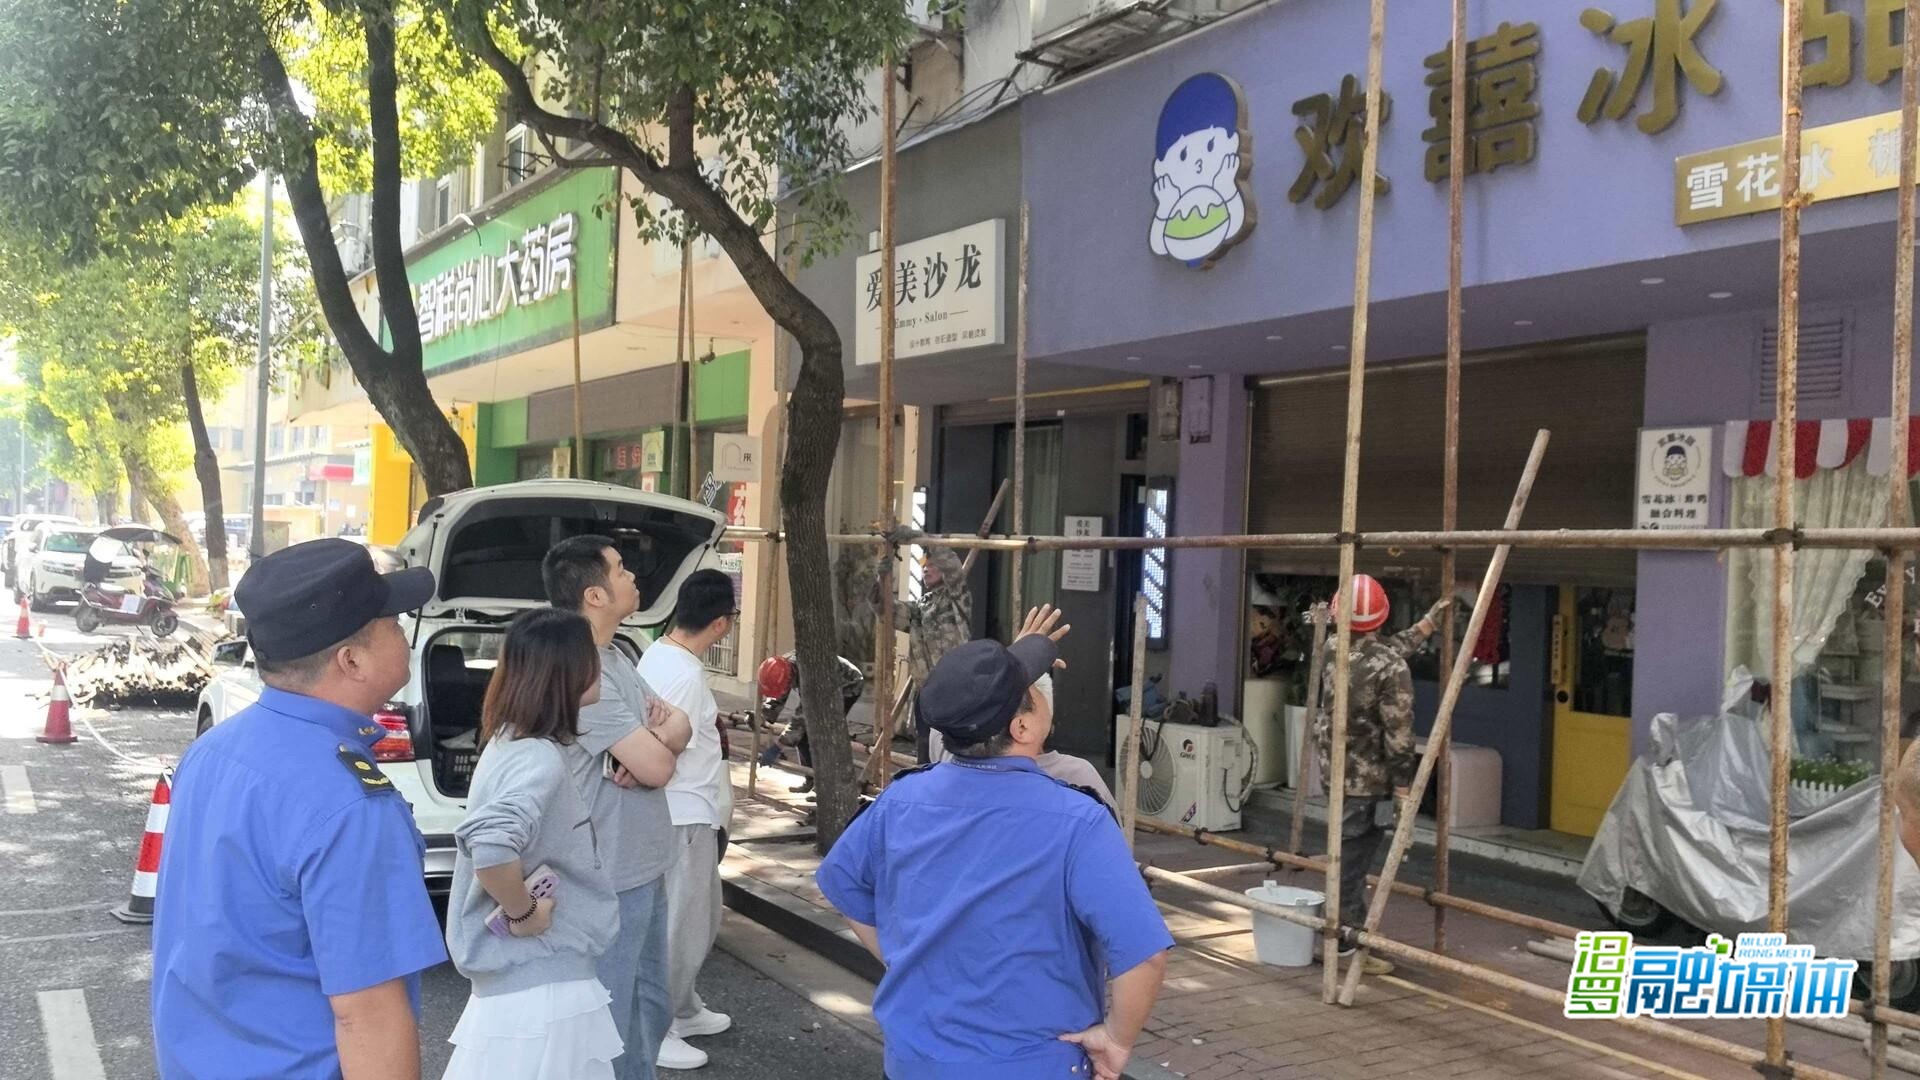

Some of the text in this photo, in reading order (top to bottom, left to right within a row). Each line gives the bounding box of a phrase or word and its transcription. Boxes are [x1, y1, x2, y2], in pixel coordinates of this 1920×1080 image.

[418, 212, 574, 343] 智祥尚心大药房
[866, 244, 982, 313] 爱美沙龙
[924, 310, 948, 323] Salon
